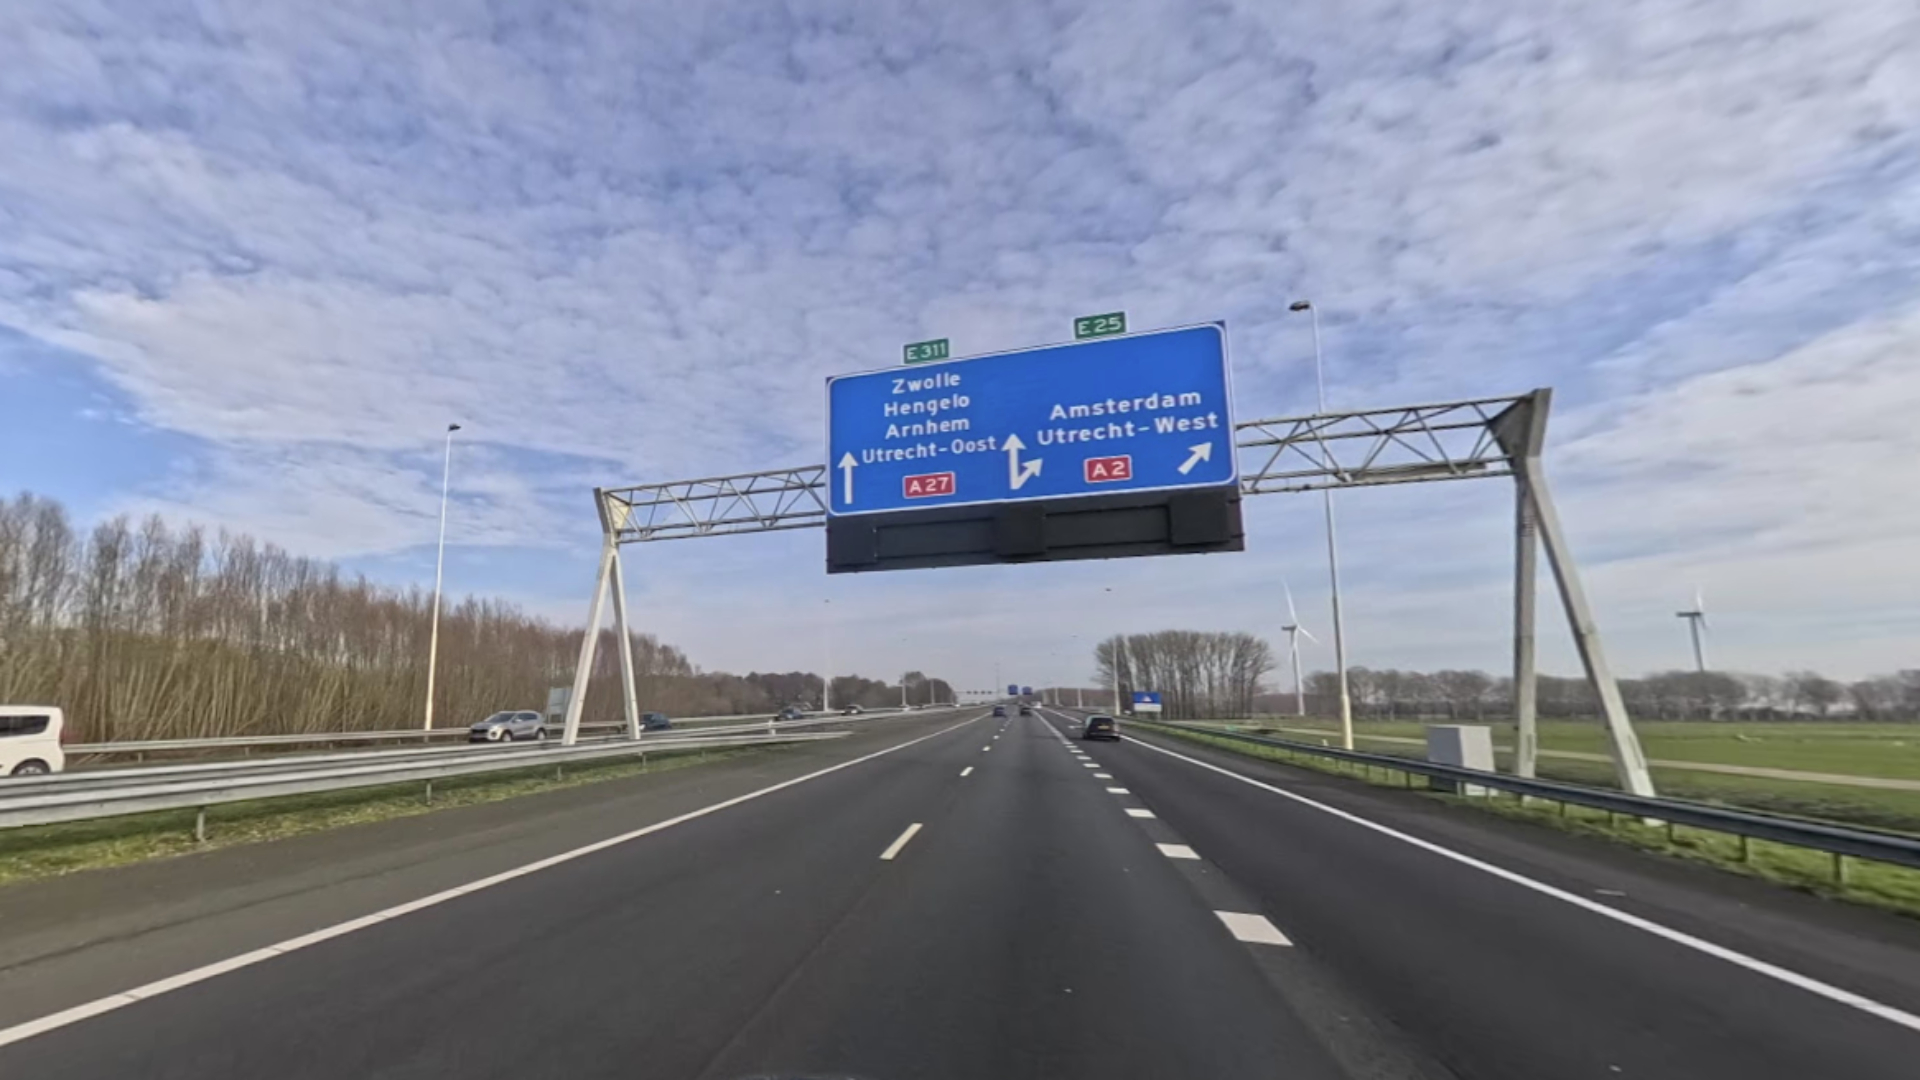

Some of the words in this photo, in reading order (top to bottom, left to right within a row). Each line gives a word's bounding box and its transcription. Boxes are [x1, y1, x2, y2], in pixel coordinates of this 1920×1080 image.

[892, 373, 961, 394] Zwolle
[884, 394, 970, 418] Hengelo
[1050, 392, 1201, 420] Amsterdam
[886, 418, 970, 440] Arnhem
[1037, 413, 1219, 446] Utrecht-West
[862, 437, 996, 465] Utrecht-Oost
